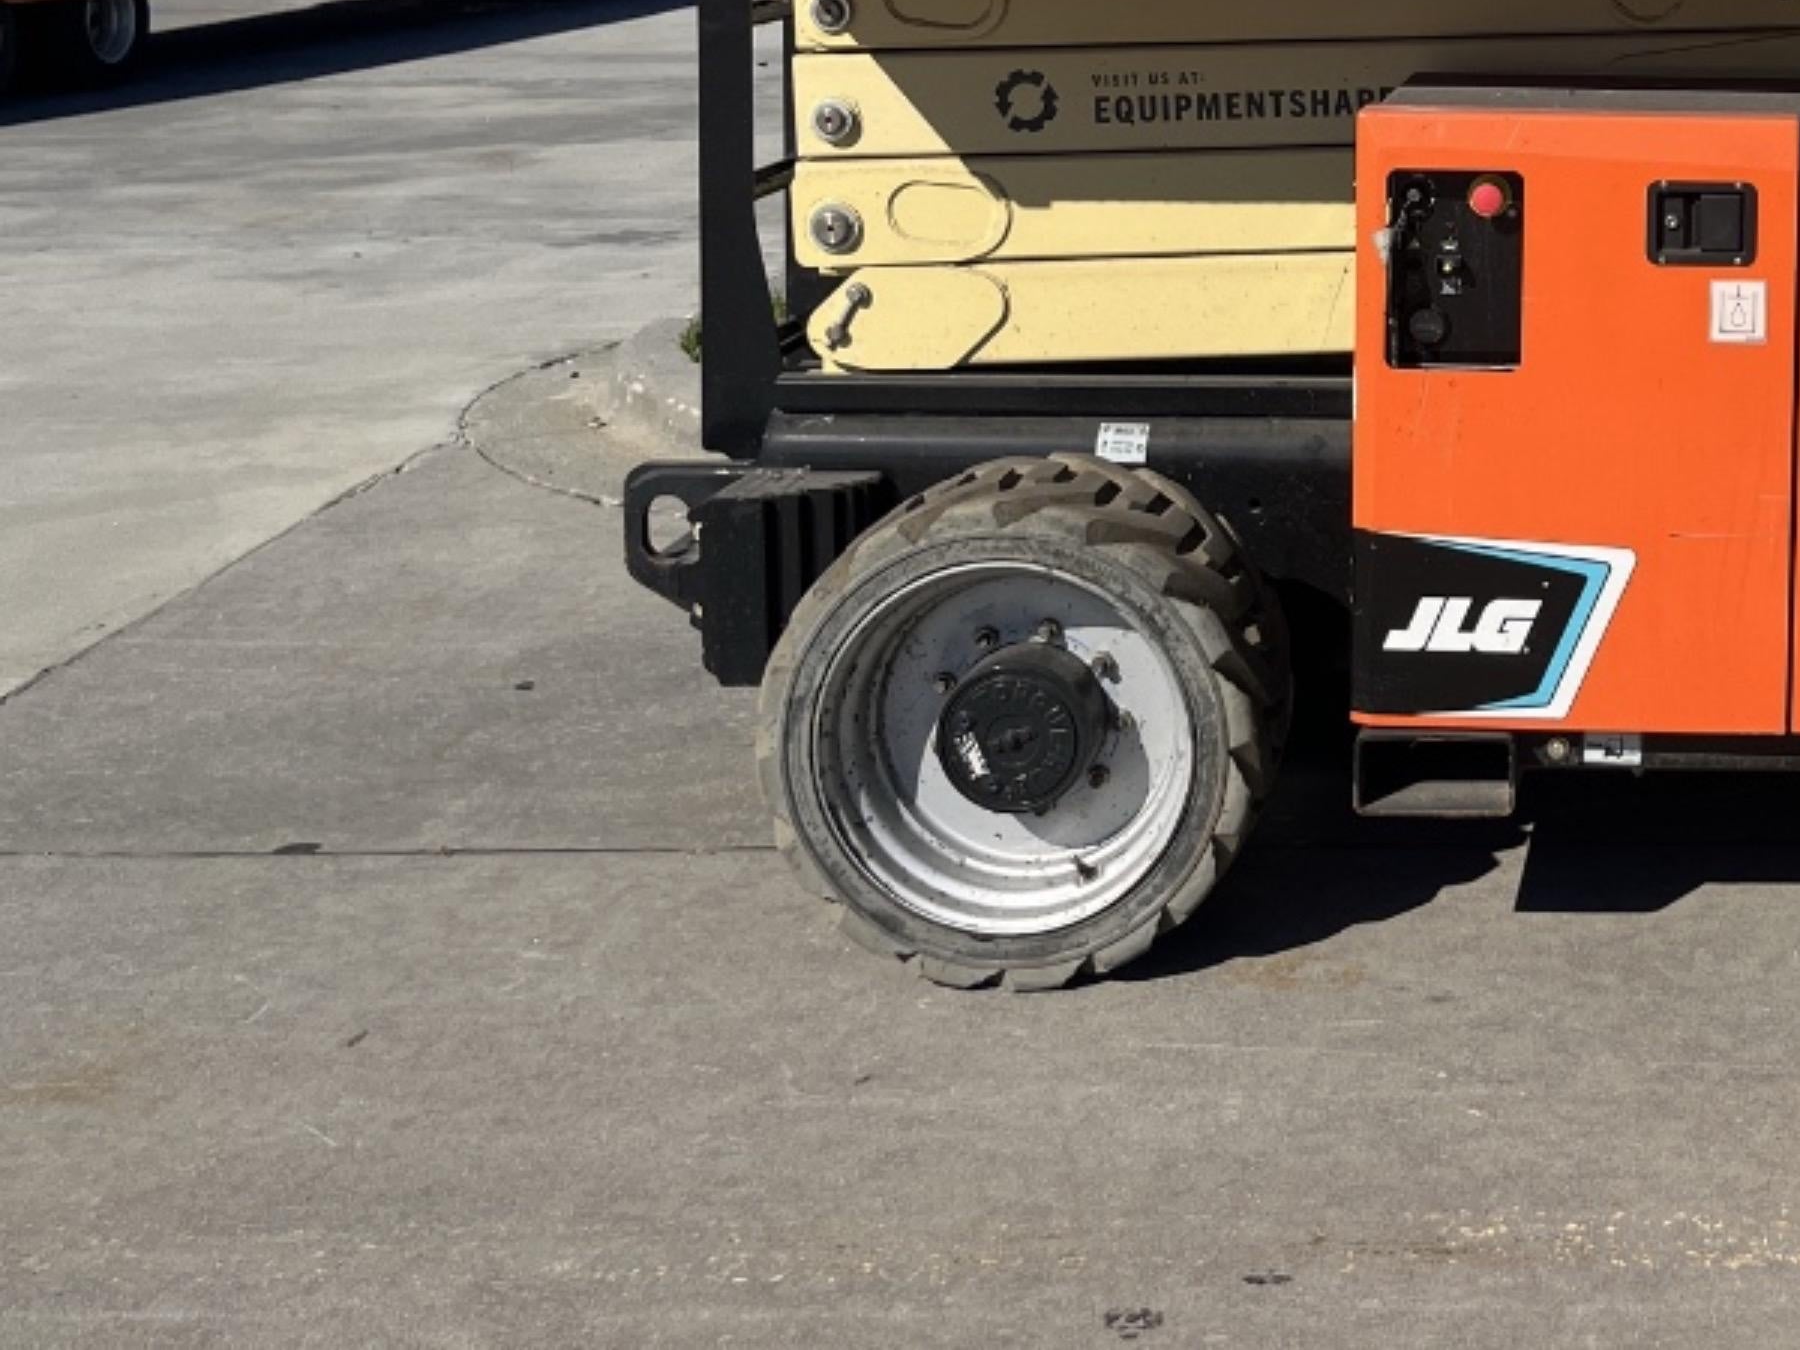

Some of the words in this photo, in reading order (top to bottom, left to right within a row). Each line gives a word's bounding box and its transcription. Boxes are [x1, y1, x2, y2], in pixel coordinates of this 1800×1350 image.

[1091, 73, 1139, 88] VISIT
[1147, 72, 1169, 87] US
[1382, 596, 1543, 654] JLG
